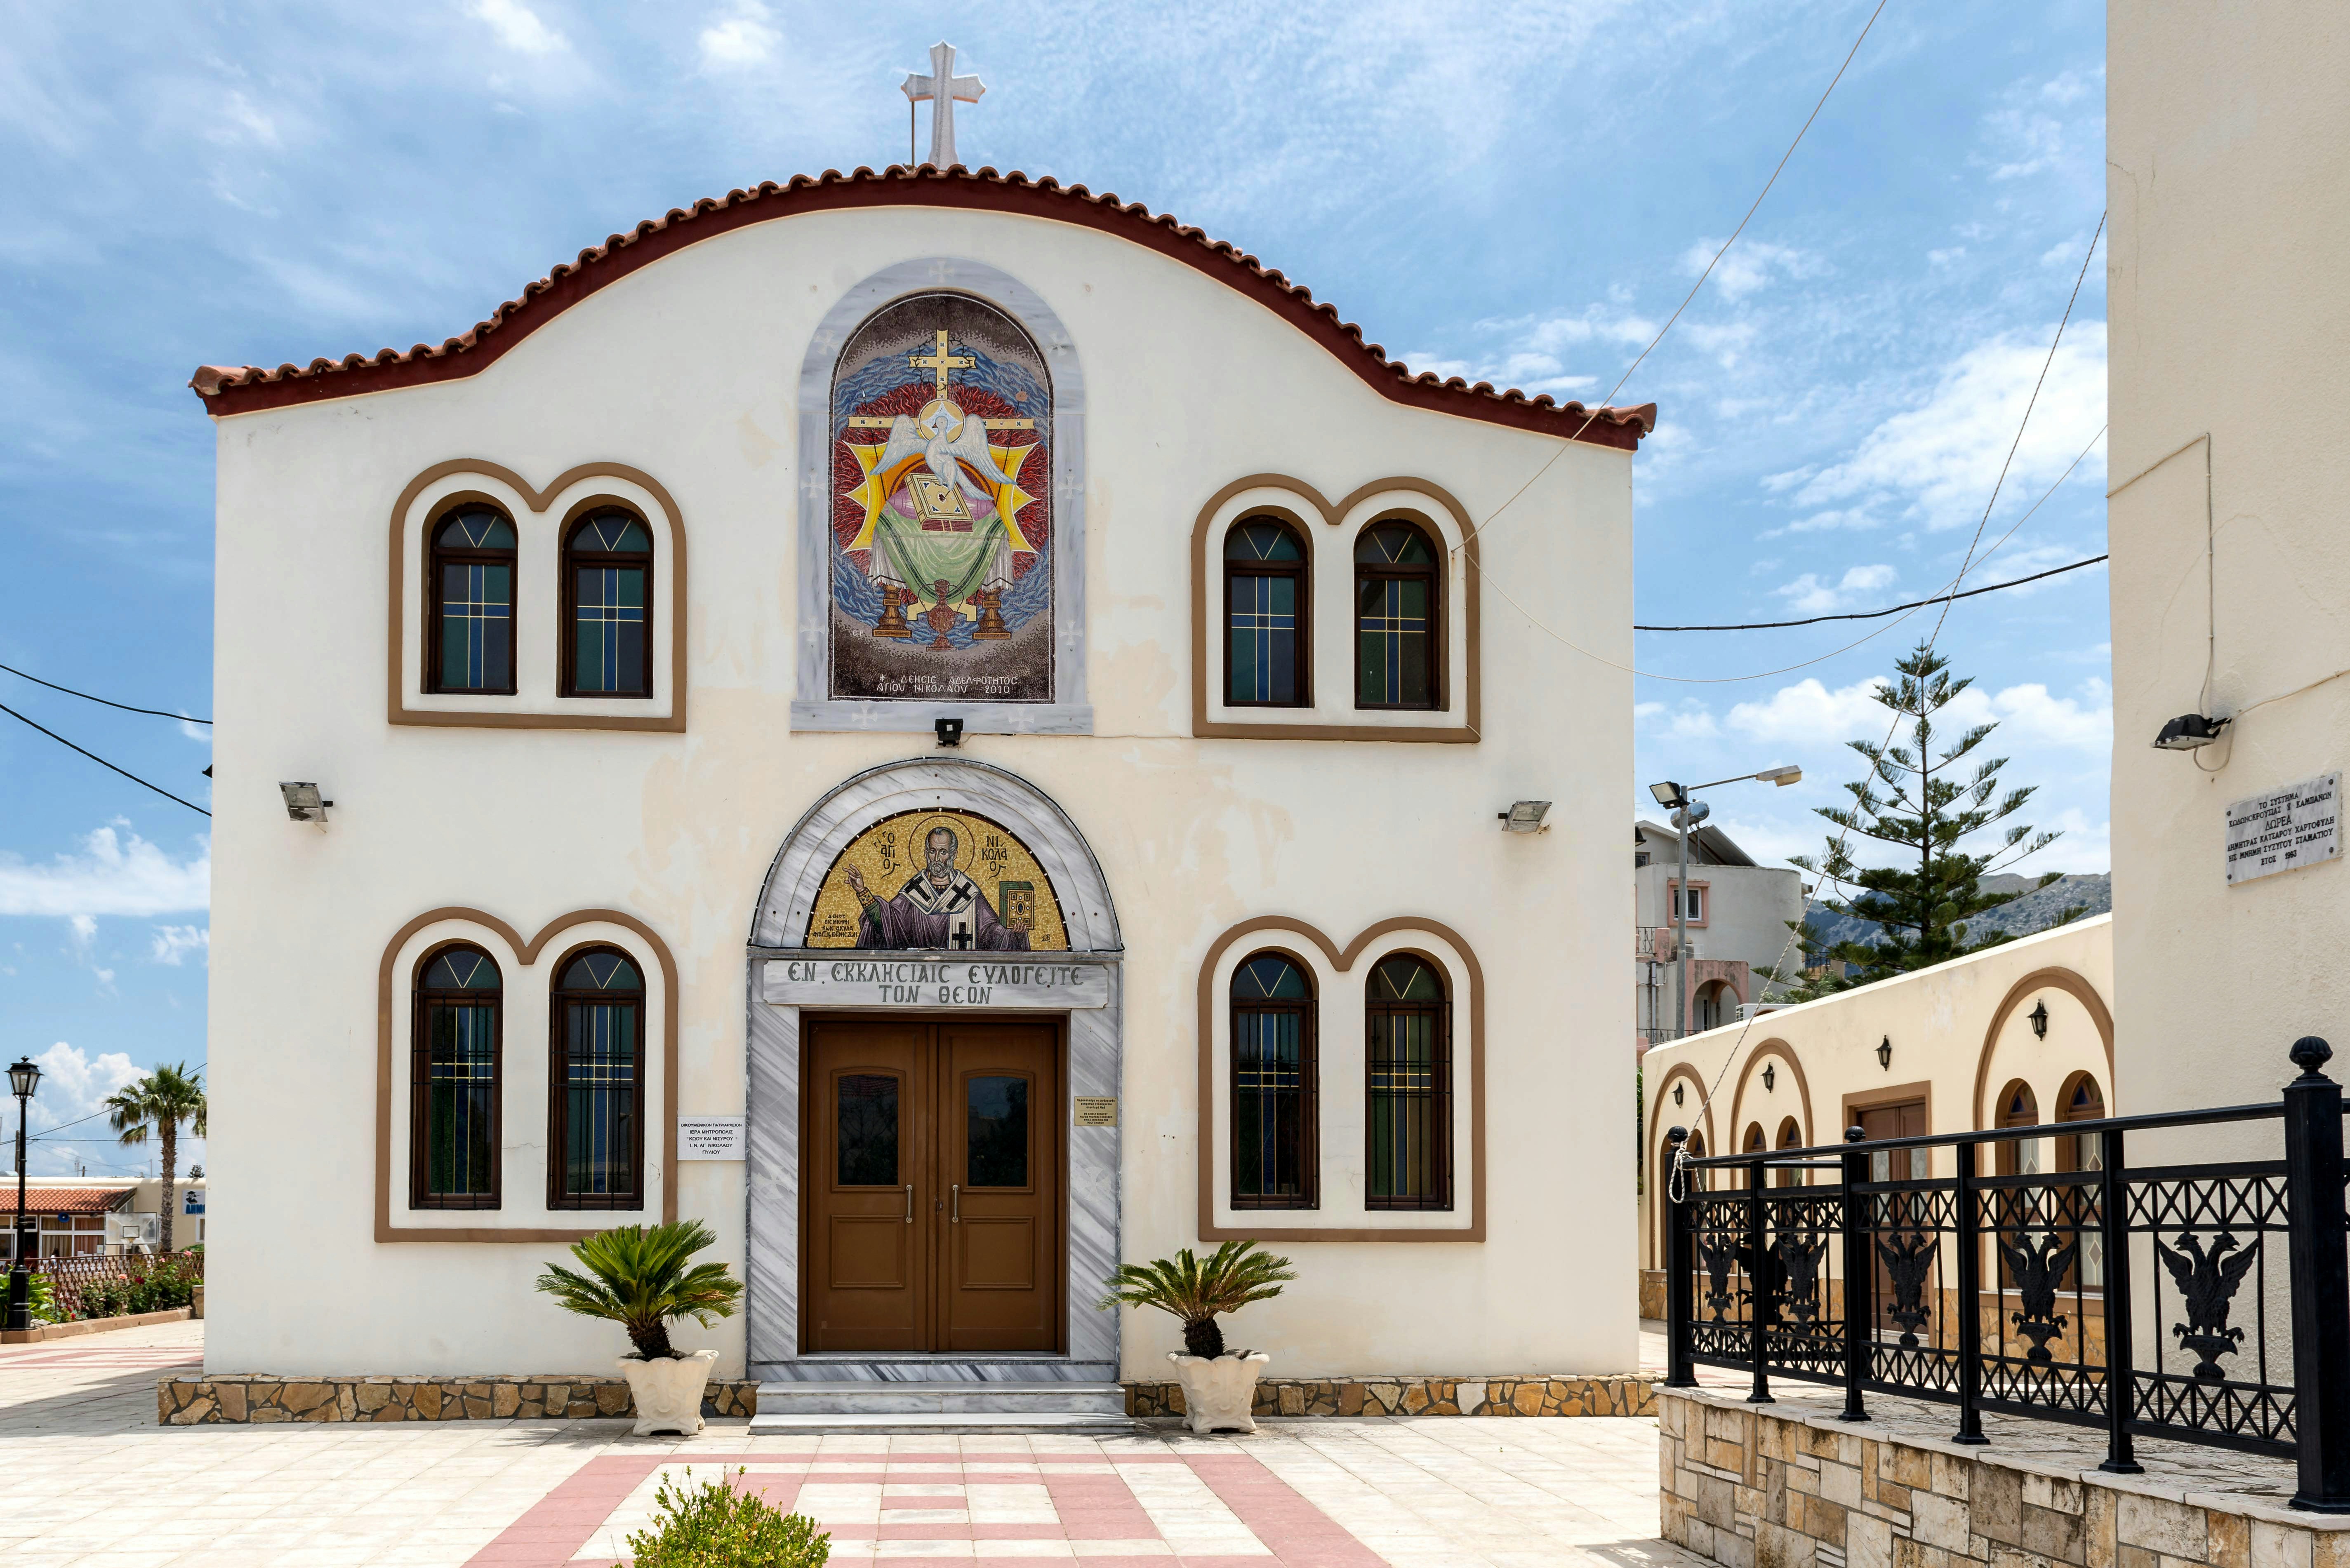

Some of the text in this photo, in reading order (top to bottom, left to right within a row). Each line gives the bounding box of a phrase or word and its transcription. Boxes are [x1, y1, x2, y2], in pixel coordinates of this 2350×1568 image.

[2270, 792, 2298, 806] ΣΥΣΤΗΜΑ
[2296, 792, 2332, 808] ΚΑΜΠΑΝΩΝ
[2265, 814, 2292, 831] ΔΩΡΕΑ
[987, 836, 998, 847] ΝΙ
[2228, 816, 2334, 851] ΔΗΜΗΤΡΑΣ ΚΑΤΣΑΡΟΥ ΧΑΡΤΟΦΥΛΗ
[2239, 847, 2261, 859] ΜΝΗΜΗ
[2264, 839, 2293, 853] ΣΥΖΥΓΟΥ
[2296, 828, 2333, 844] ΣΤΑΜΑΤΙΟΥ
[2261, 856, 2276, 865] ΕΤΟΣ
[879, 985, 992, 1004] ΤΟΝ ΘΕΟΝ
